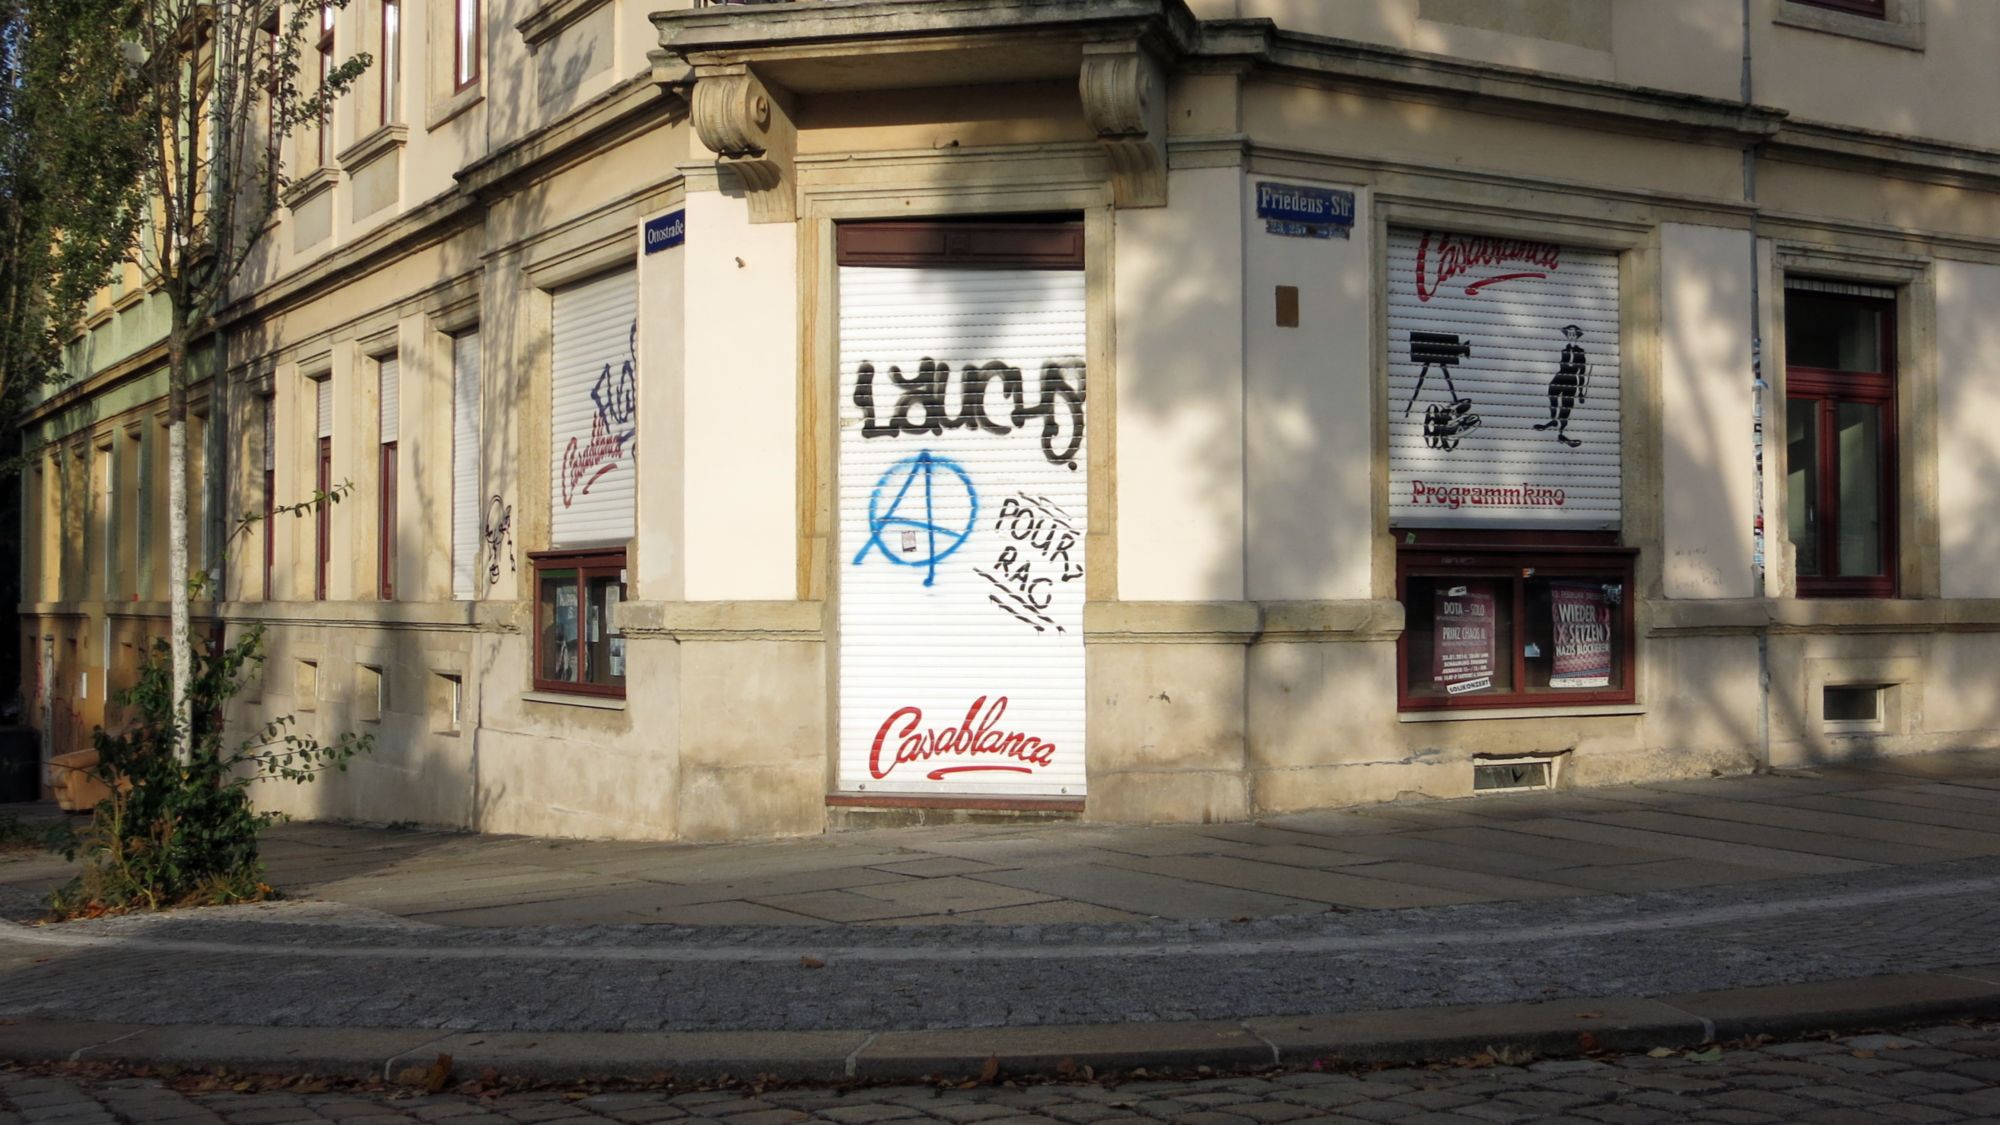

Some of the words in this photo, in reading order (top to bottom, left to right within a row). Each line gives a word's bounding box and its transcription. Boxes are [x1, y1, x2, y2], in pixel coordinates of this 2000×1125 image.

[648, 219, 684, 244] Ottostraße
[1411, 480, 1566, 509] Programmkino
[1444, 601, 1463, 616] DOTA
[1558, 603, 1596, 622] WIEDER
[1555, 644, 1576, 656] NAZIS
[868, 695, 1056, 780] Casablanca
